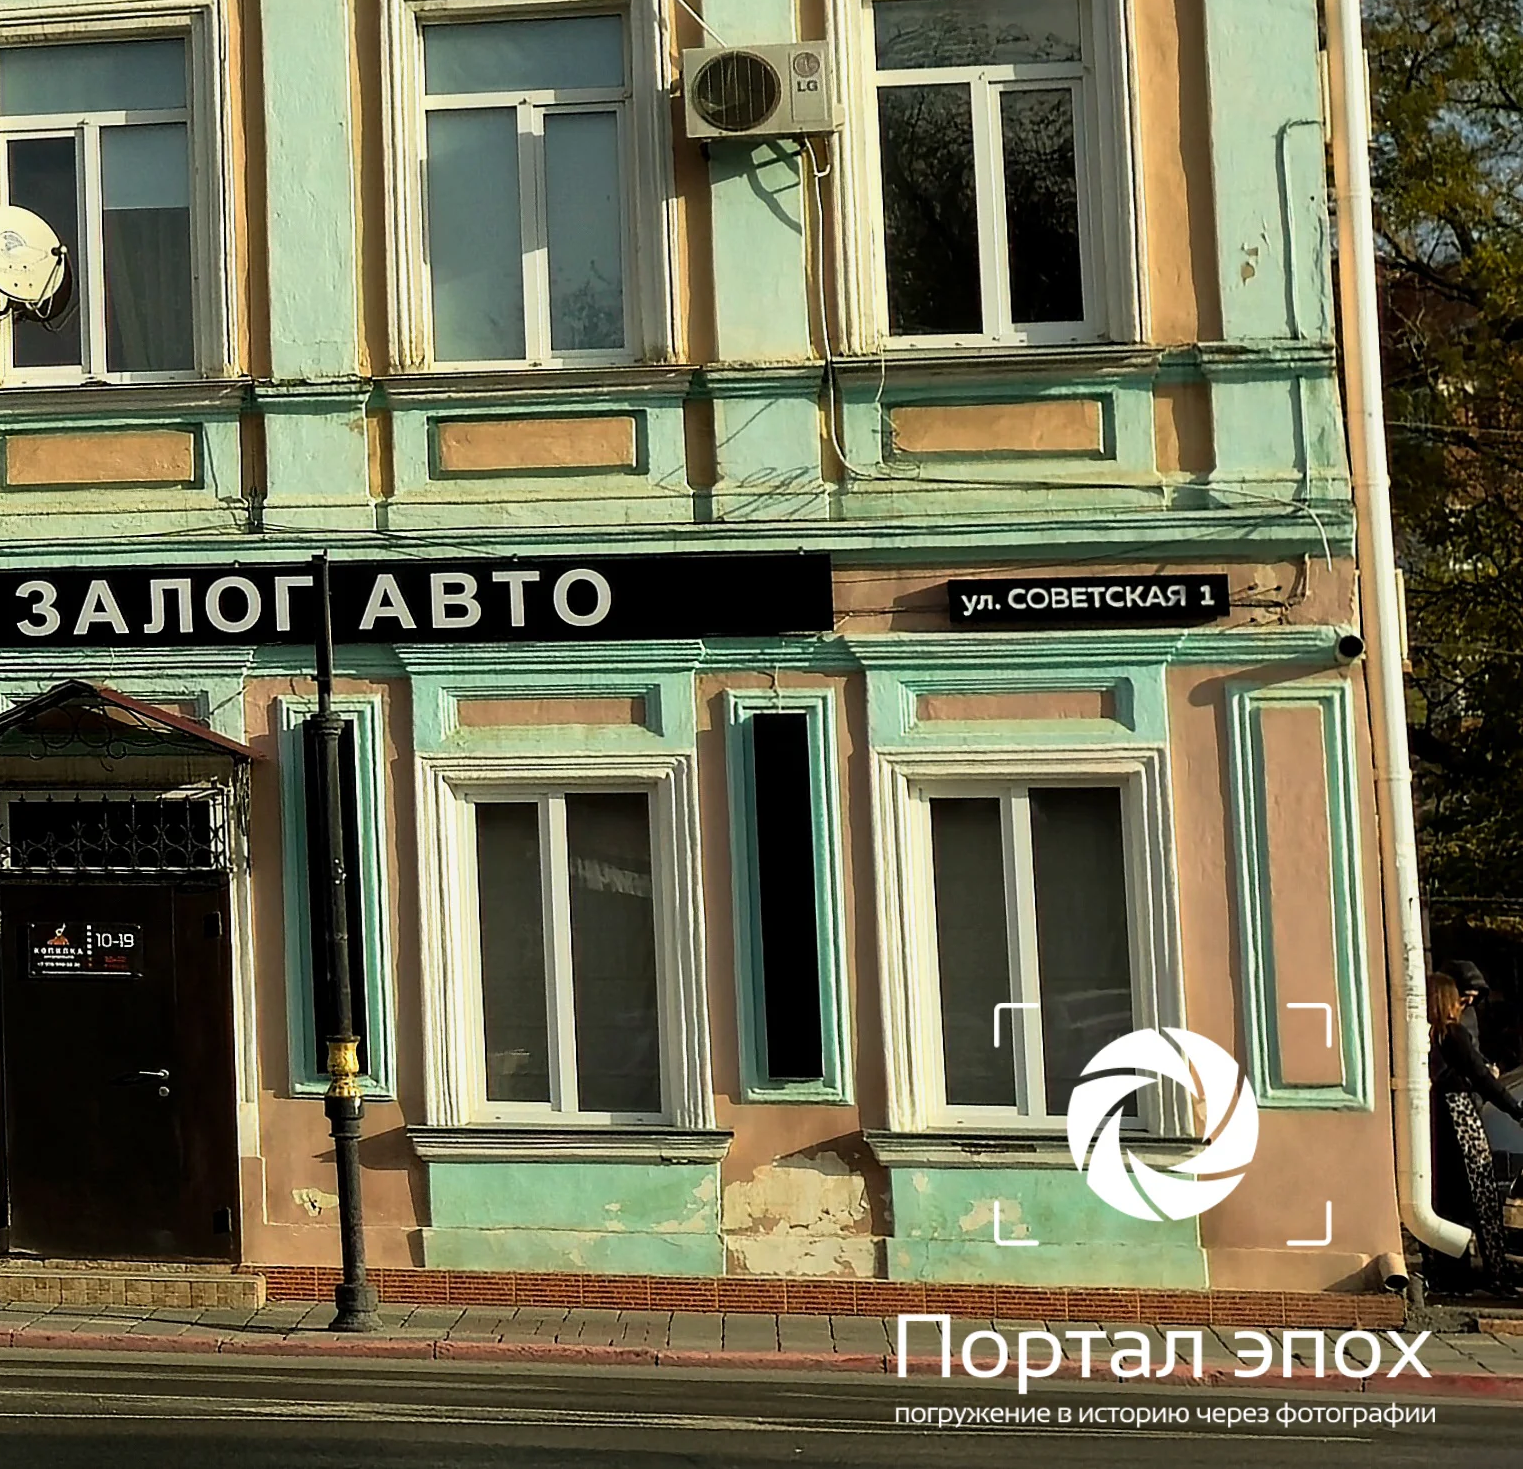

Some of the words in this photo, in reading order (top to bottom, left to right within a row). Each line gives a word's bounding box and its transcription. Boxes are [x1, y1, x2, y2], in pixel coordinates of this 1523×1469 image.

[797, 80, 819, 93] LG
[16, 575, 314, 636] ЗАЛОГ
[359, 568, 612, 629] АВТО
[960, 594, 1001, 616] ул.
[1007, 585, 1187, 610] СОВЕТСКАЯ
[1200, 585, 1215, 606] 1
[95, 933, 135, 948] 10-19
